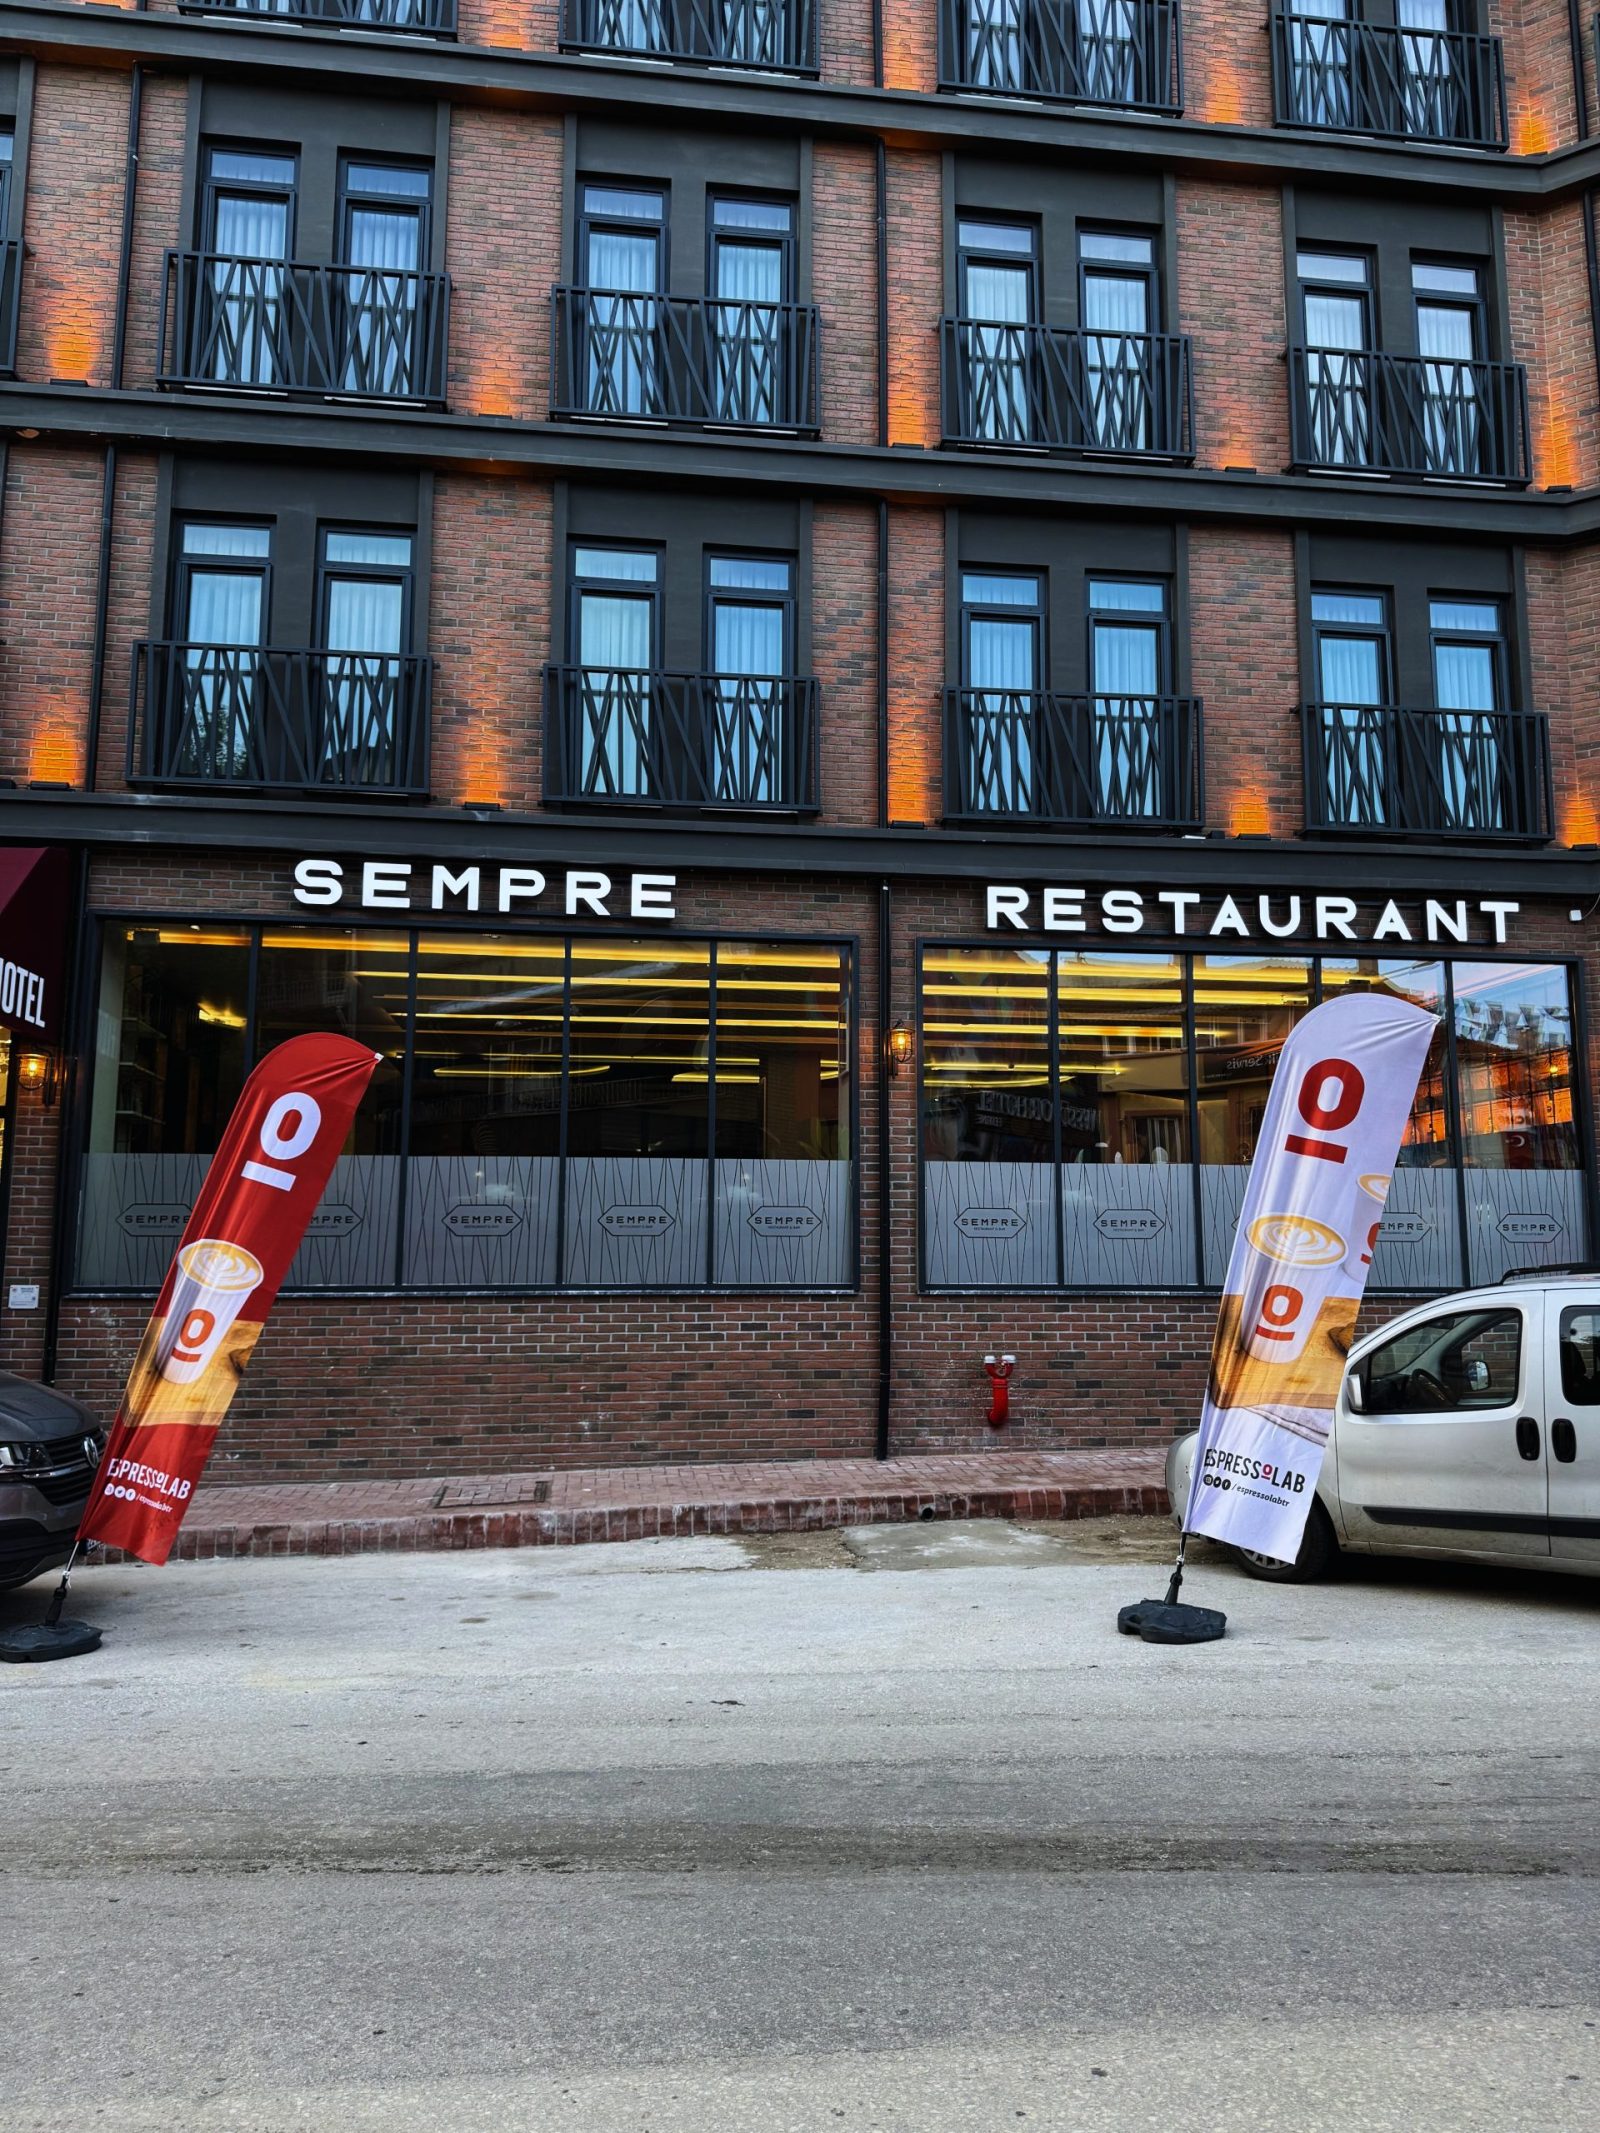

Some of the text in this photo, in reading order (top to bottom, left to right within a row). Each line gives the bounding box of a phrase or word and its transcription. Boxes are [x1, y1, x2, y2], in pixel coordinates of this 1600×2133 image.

[293, 859, 677, 918] SEMPRE
[986, 886, 1520, 943] RESTAURANT
[309, 1215, 354, 1224] MPRE
[450, 1215, 514, 1224] SEMPRE
[605, 1216, 668, 1224] SEMPRE
[754, 1216, 814, 1225] SEMPRE
[961, 1218, 1019, 1227] SEMPRE
[1100, 1219, 1158, 1228] SEMPRE
[1378, 1222, 1424, 1231] EMPRE
[1502, 1223, 1556, 1232] SEMPRE
